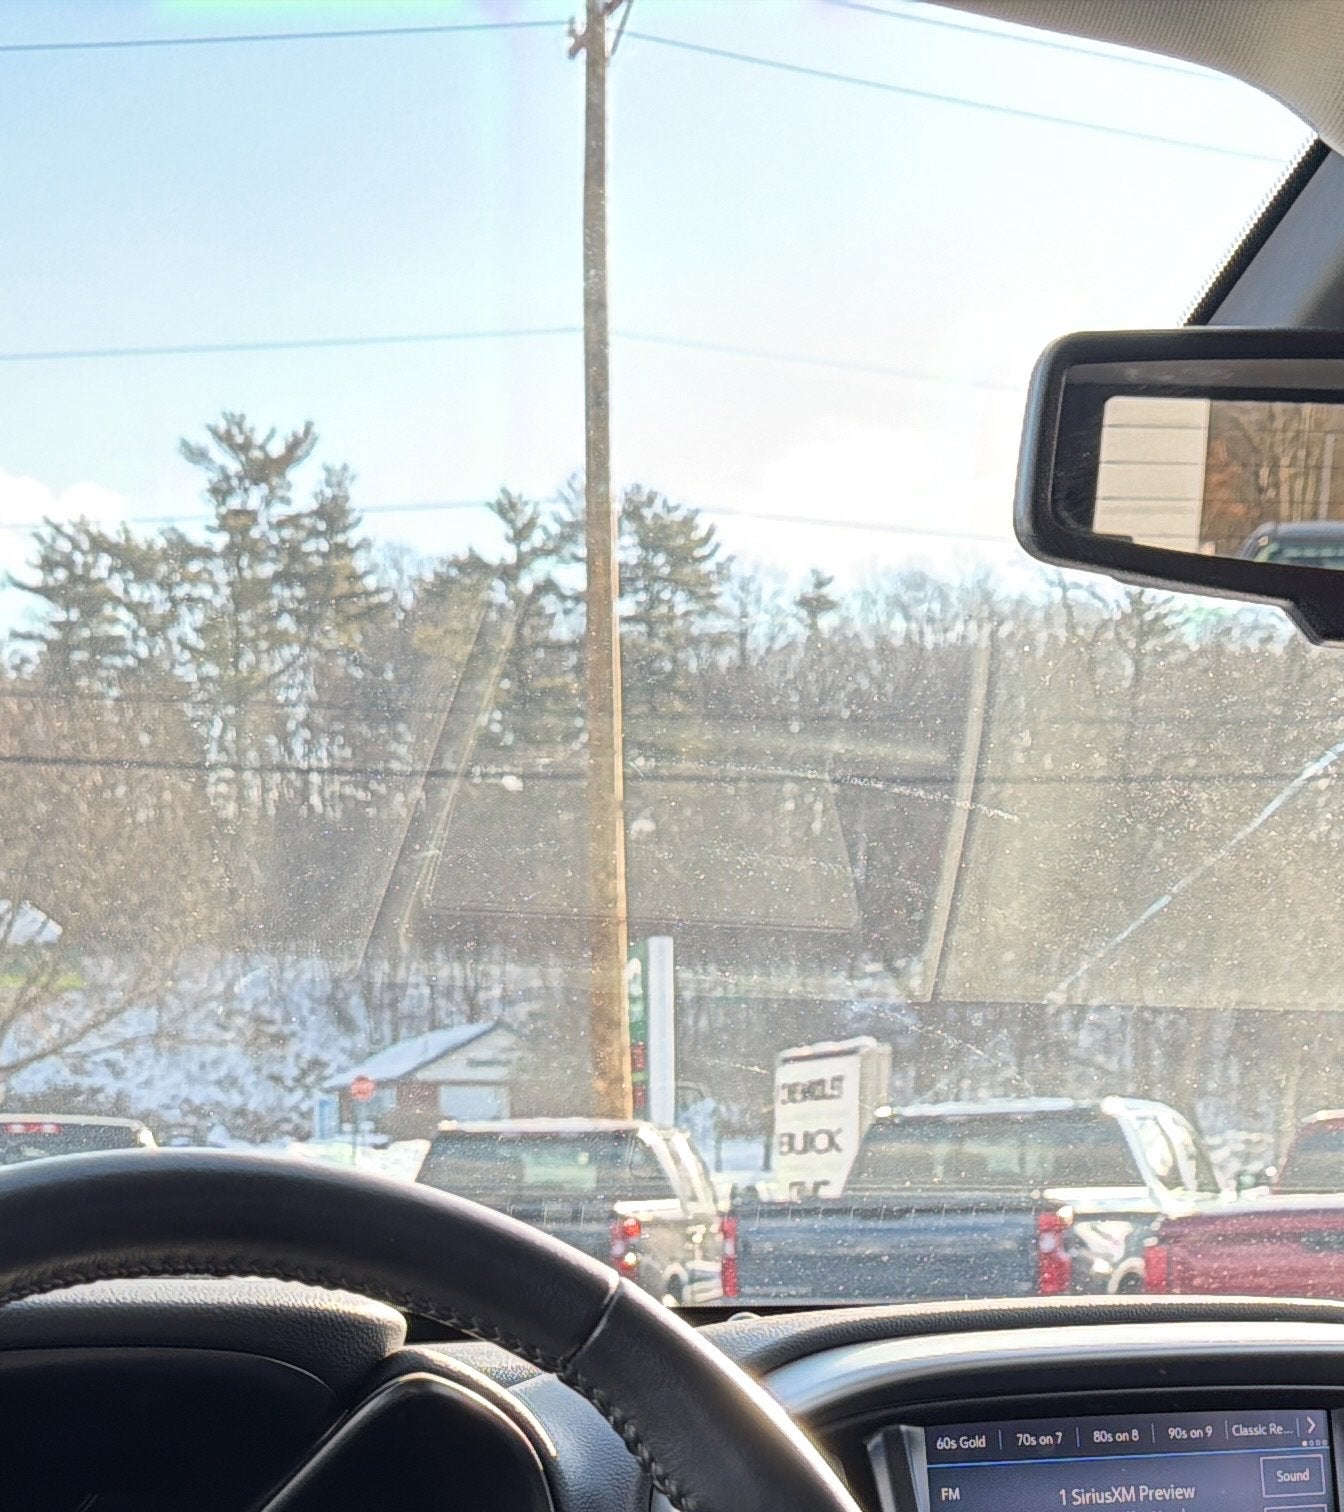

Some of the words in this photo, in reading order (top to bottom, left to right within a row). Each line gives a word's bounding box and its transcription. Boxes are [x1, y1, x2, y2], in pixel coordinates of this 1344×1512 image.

[1093, 1430, 1113, 1443] 80s
[1115, 1432, 1129, 1442] on
[1131, 1429, 1140, 1442] 8
[1168, 1427, 1188, 1440] 90s
[1190, 1428, 1203, 1438] on
[1205, 1425, 1213, 1438] 9
[1232, 1423, 1267, 1437] Classic
[936, 1437, 957, 1450] 60s
[959, 1435, 986, 1449] Gold
[1016, 1433, 1036, 1446] 70s
[1039, 1435, 1053, 1445] on
[1055, 1432, 1063, 1445] 7
[1276, 1468, 1310, 1483] Sound
[941, 1487, 960, 1501] FM
[1059, 1488, 1067, 1506] 1
[1072, 1486, 1135, 1506] SiriusXM
[1139, 1484, 1196, 1502] Preview
